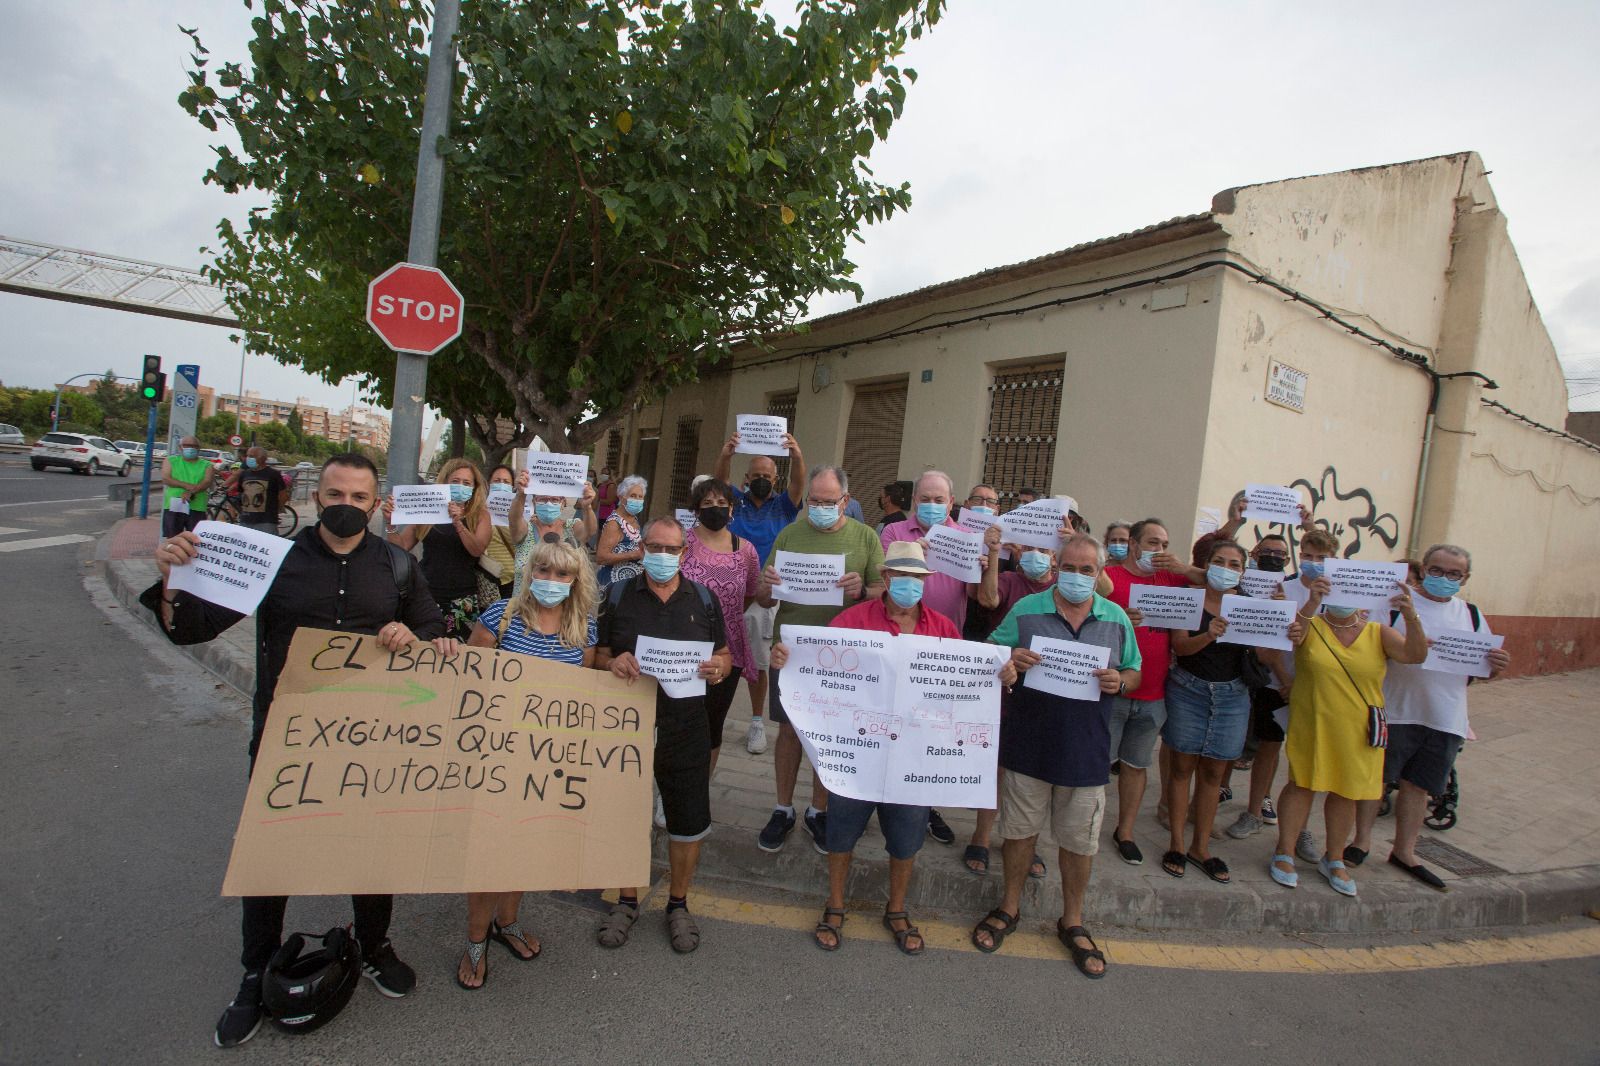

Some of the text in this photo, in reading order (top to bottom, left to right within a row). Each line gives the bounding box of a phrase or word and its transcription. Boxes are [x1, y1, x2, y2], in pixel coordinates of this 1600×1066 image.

[376, 294, 455, 323] STOP
[176, 394, 194, 408] 36
[248, 542, 258, 552] IR
[259, 545, 270, 556] AL
[929, 538, 956, 550] MERCADO
[193, 541, 272, 569] ERCADO CENTRAL!
[950, 551, 961, 559] DEL
[222, 561, 237, 572] DEL
[238, 566, 248, 575] 04
[249, 569, 256, 577] Y
[256, 572, 267, 581] 05
[784, 561, 819, 569] ¡QUEREMOS
[1336, 567, 1376, 575] ¡QUEREMOS
[195, 566, 249, 590] VECINOS RABASA
[780, 568, 809, 576] MERCADO
[1232, 607, 1269, 615] ¡QUEREMOS
[796, 637, 884, 649] Estamos hasta los
[646, 648, 684, 657] ¡QUEREMOS
[917, 651, 971, 663] ¡QUEREMOS
[974, 656, 983, 664] IR
[1042, 646, 1082, 658] ¡QUEREMOS
[311, 635, 523, 682] EL BARRIO
[641, 655, 673, 665] MERCADO
[639, 665, 665, 674] VUELTA
[799, 666, 879, 683] del abandono del
[910, 663, 996, 676] MERCADO CENTRAL!
[1063, 667, 1076, 675] DEL
[910, 676, 947, 686] VUELTA
[949, 679, 966, 688] DEL
[1044, 672, 1066, 682] VECINOS
[821, 680, 856, 692] Rabasa
[923, 691, 955, 699] VECINOS
[452, 689, 640, 732] DE RABASA
[869, 722, 889, 734] 04
[836, 734, 880, 749] también
[970, 733, 987, 743] 05
[285, 715, 642, 778] EXIGIMOS QUE VUELVA
[926, 745, 966, 757] Rabasa,
[266, 761, 323, 809] EL
[339, 753, 507, 798] AUTOBÚS
[904, 773, 982, 784] abandono total
